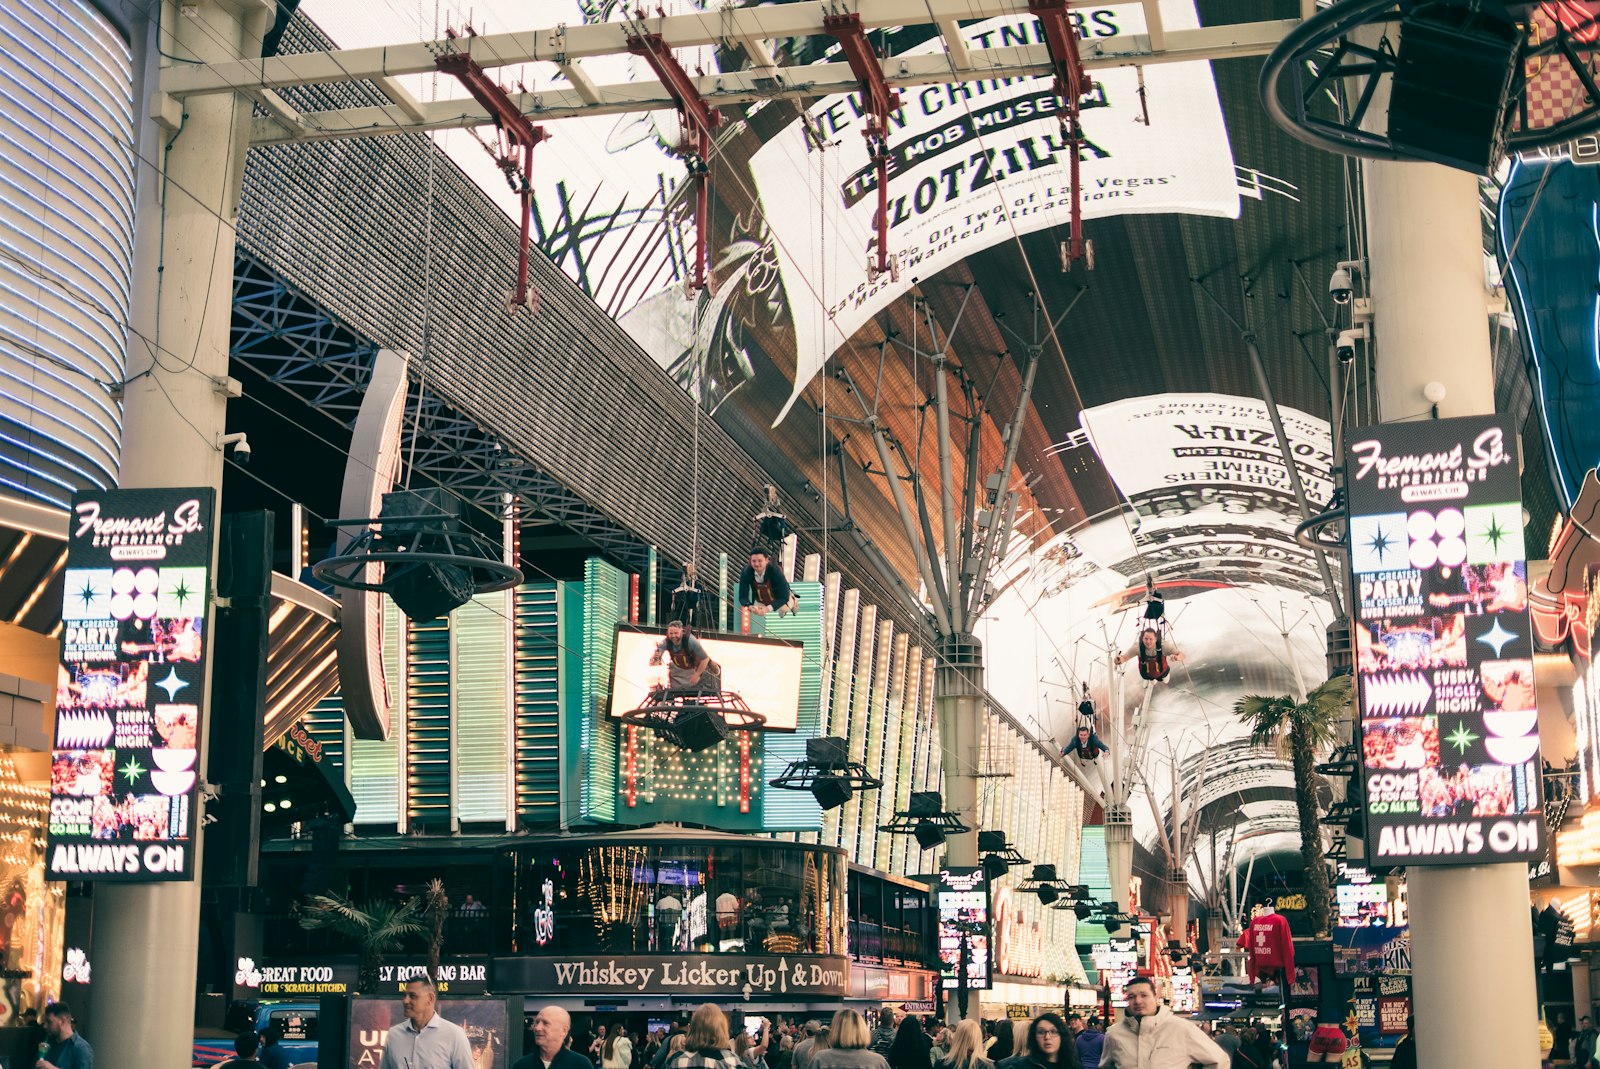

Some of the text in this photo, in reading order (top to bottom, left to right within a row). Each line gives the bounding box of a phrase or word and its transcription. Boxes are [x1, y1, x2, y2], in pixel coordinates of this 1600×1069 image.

[904, 124, 966, 161] MOB
[909, 221, 985, 268] Wanted
[995, 189, 1134, 227] Attracions
[828, 282, 866, 321] Save
[929, 224, 955, 246] On
[963, 204, 1002, 226] Two
[1014, 192, 1036, 207] of
[1177, 448, 1261, 459] MUSEUM
[1352, 439, 1462, 480] Fremont
[1203, 461, 1286, 479] CRIME
[1163, 472, 1294, 491] PARTNERS
[1378, 467, 1487, 489] EXPERIENCE
[1411, 489, 1443, 497] ALWAYS
[76, 501, 165, 537] Fremont
[92, 533, 184, 547] EXPERIENCE
[1360, 569, 1422, 582] THE GREATEST
[1360, 577, 1422, 600] PARTY
[1361, 594, 1423, 609] THE DESERT HAS
[1361, 607, 1384, 619] EVER
[67, 619, 118, 629] THE GREATEST
[65, 627, 119, 645] PARTY
[65, 643, 77, 652] THE
[1368, 774, 1418, 792] COME
[1369, 793, 1380, 803] AS
[1381, 791, 1400, 802] YOU
[51, 798, 92, 816] COME
[1369, 803, 1389, 815] GO
[1390, 802, 1405, 814] ALL
[49, 823, 66, 835] GO
[66, 823, 80, 835] ALL
[1377, 819, 1539, 856] ALWAYS ON
[51, 844, 184, 873] ALWAYS ON
[300, 967, 333, 982] FOOD
[460, 965, 486, 980] BAR
[553, 960, 844, 991] Whiskey Licker Up & Down
[264, 983, 279, 993] OUR
[316, 983, 347, 993] KITCHEN
[904, 1002, 934, 1010] ENTRANCE
[1356, 1010, 1376, 1018] ICK
[1382, 1013, 1408, 1022] BITCH
